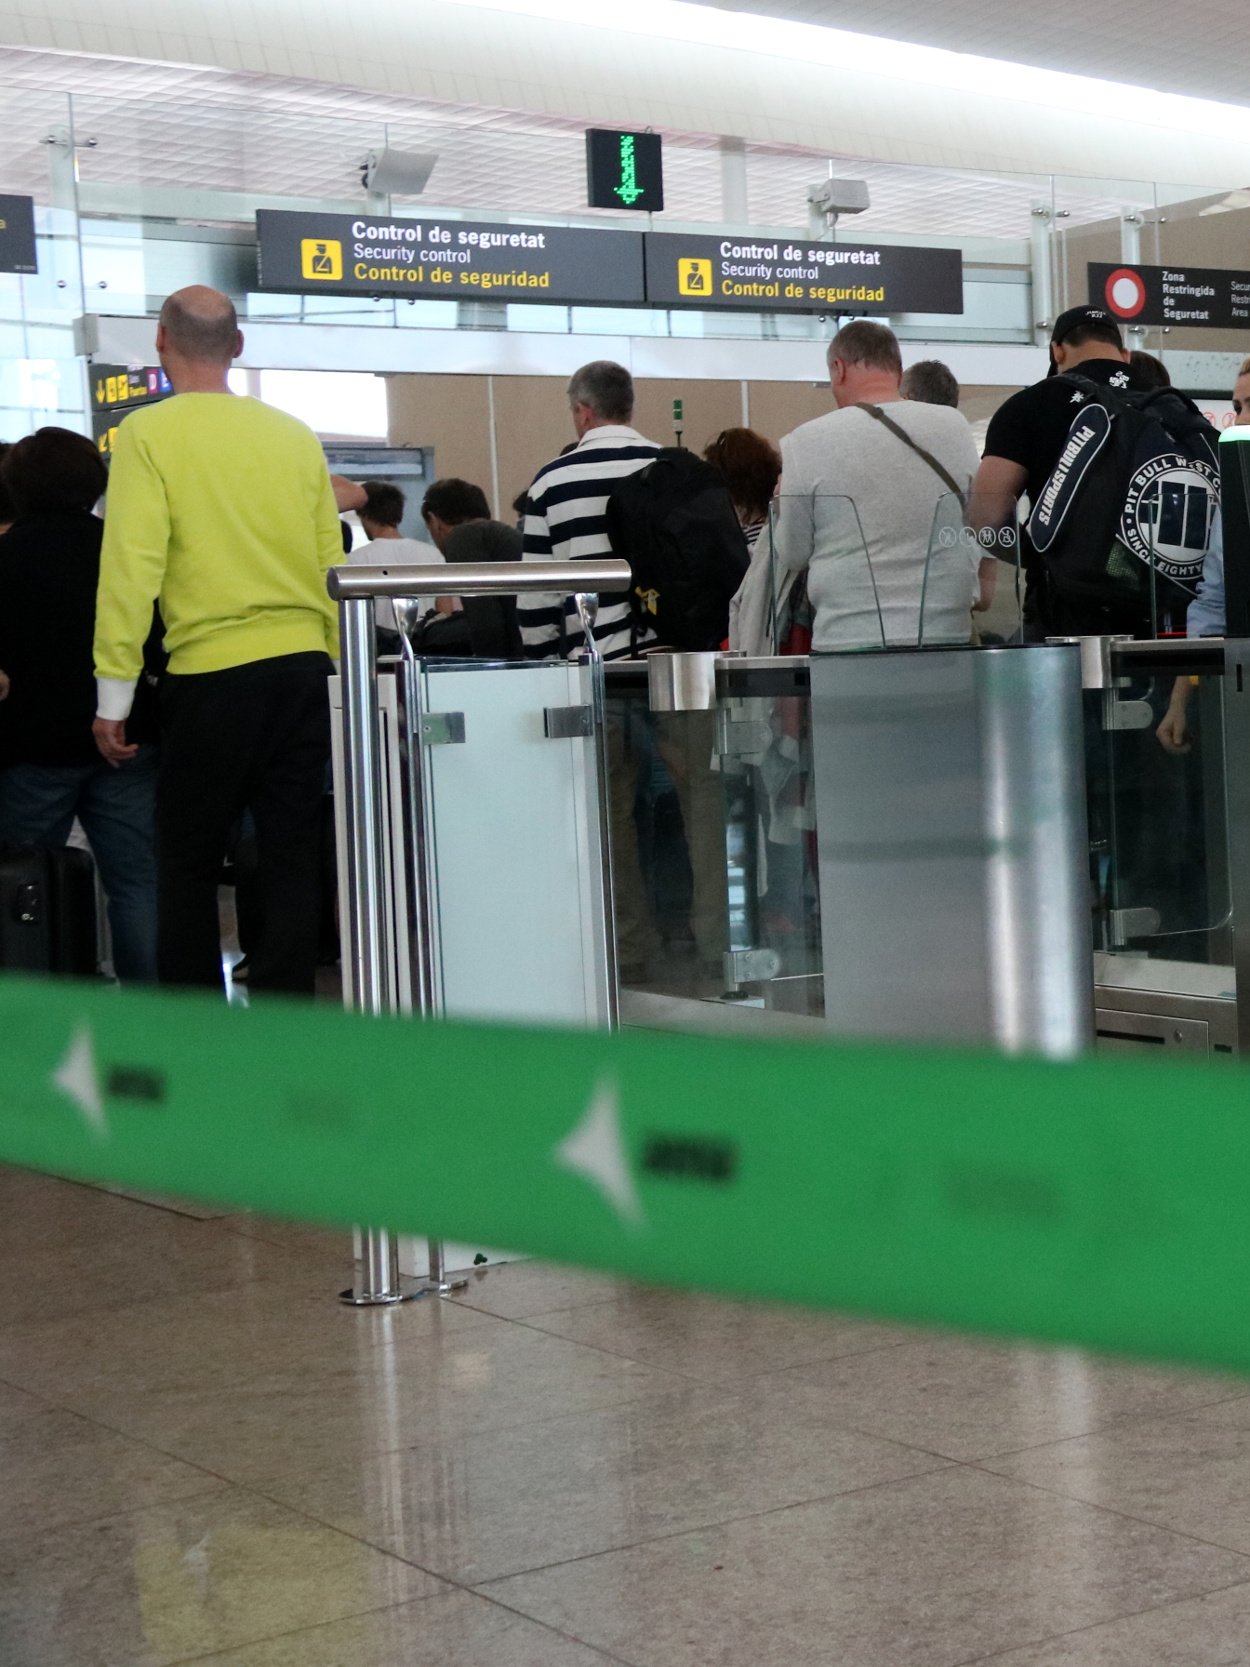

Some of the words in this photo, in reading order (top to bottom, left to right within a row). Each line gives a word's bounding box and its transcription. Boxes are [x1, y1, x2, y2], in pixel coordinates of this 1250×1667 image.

[352, 221, 422, 241] Control
[428, 225, 451, 243] de
[458, 229, 546, 248] seguretat
[354, 243, 415, 263] Security
[420, 247, 471, 263] control
[720, 242, 778, 260] Control
[783, 246, 802, 262] de
[808, 249, 881, 266] seguretat
[354, 263, 424, 282] Control
[430, 266, 453, 283] de
[459, 270, 550, 289] seguridad
[721, 262, 772, 280] Security
[776, 266, 819, 280] control
[1162, 271, 1185, 282] Zona
[722, 280, 779, 297] Control
[784, 283, 804, 298] de
[809, 286, 884, 302] seguridad
[1162, 284, 1215, 297] Restringida
[1163, 297, 1175, 306] de
[1164, 308, 1209, 320] Seguretat
[1231, 309, 1249, 318] Area
[1124, 488, 1139, 514] PIT
[1135, 458, 1172, 486] BULL
